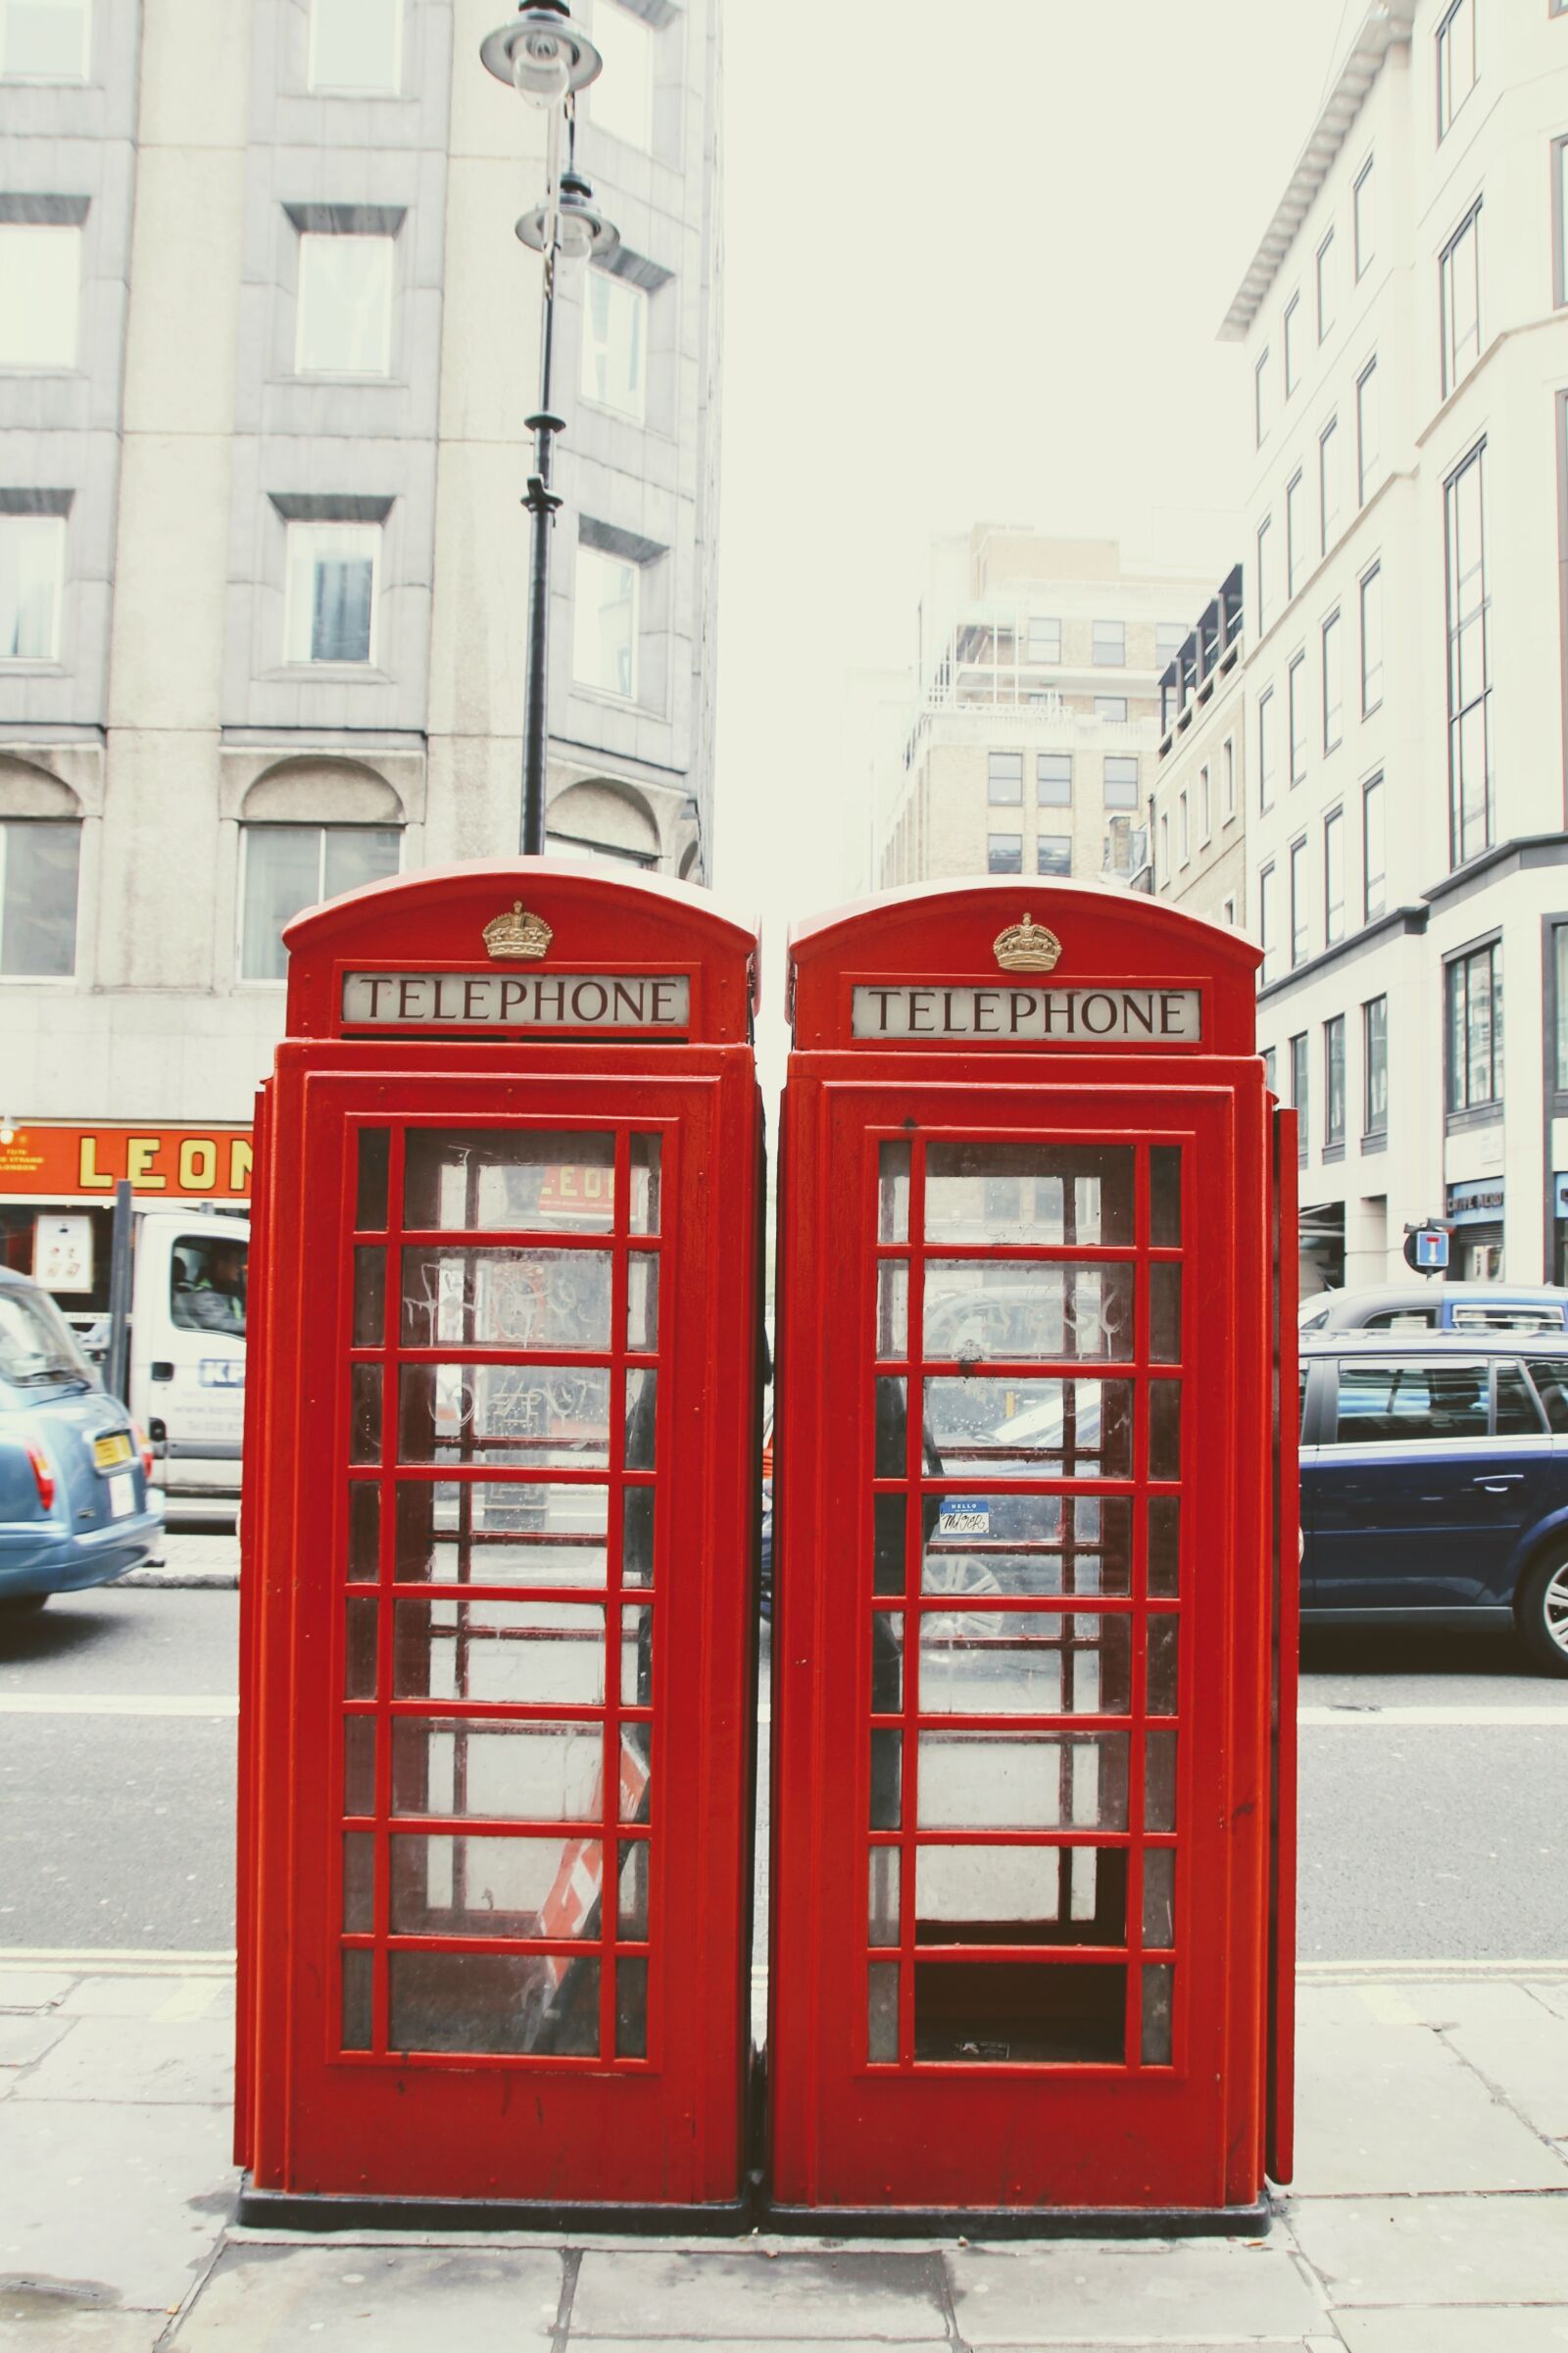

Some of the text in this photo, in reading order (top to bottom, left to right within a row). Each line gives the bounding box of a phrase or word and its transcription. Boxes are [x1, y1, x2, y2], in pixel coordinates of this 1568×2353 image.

[360, 978, 676, 1022] TELEPHONE
[867, 991, 1185, 1034] TELEPHONE
[79, 1137, 253, 1191] LEON
